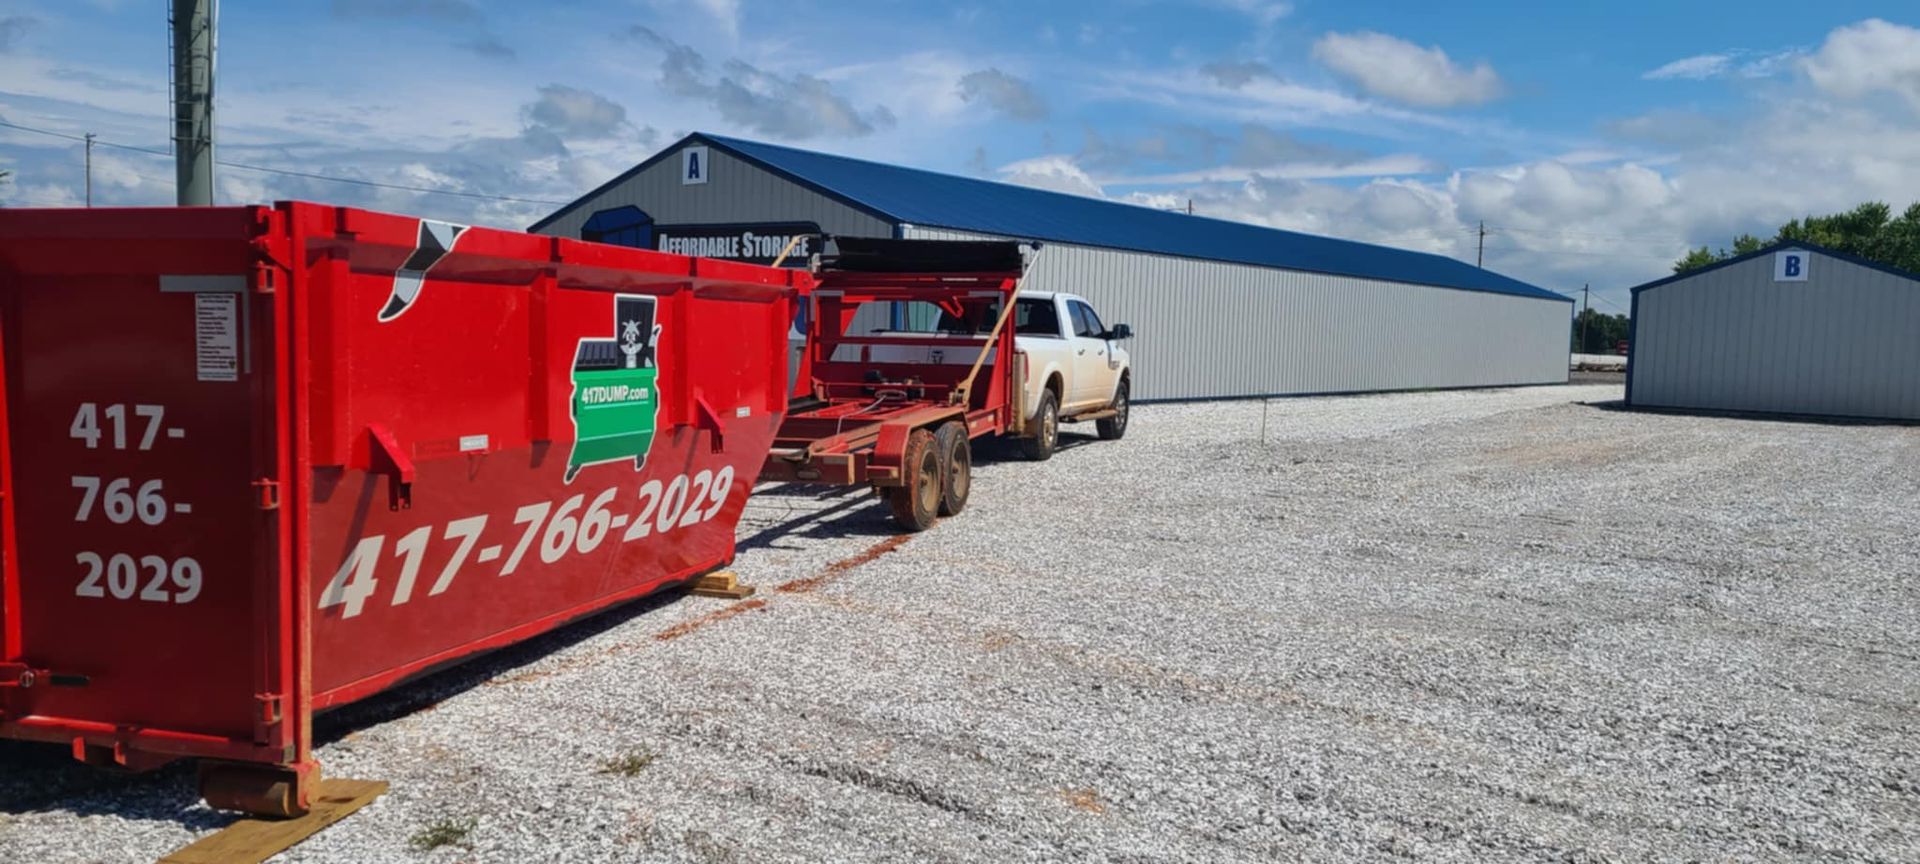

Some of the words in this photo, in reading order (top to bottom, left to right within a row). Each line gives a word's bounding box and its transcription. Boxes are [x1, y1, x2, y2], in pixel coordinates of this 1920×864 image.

[688, 152, 700, 179] A
[658, 233, 740, 257] AFFORDABLE
[1785, 255, 1801, 277] B
[581, 384, 649, 404] 417DUMP.com
[70, 403, 185, 450] 417-
[71, 476, 191, 525] 766-
[317, 465, 735, 621] 417-766-2029
[76, 551, 202, 604] 2029
